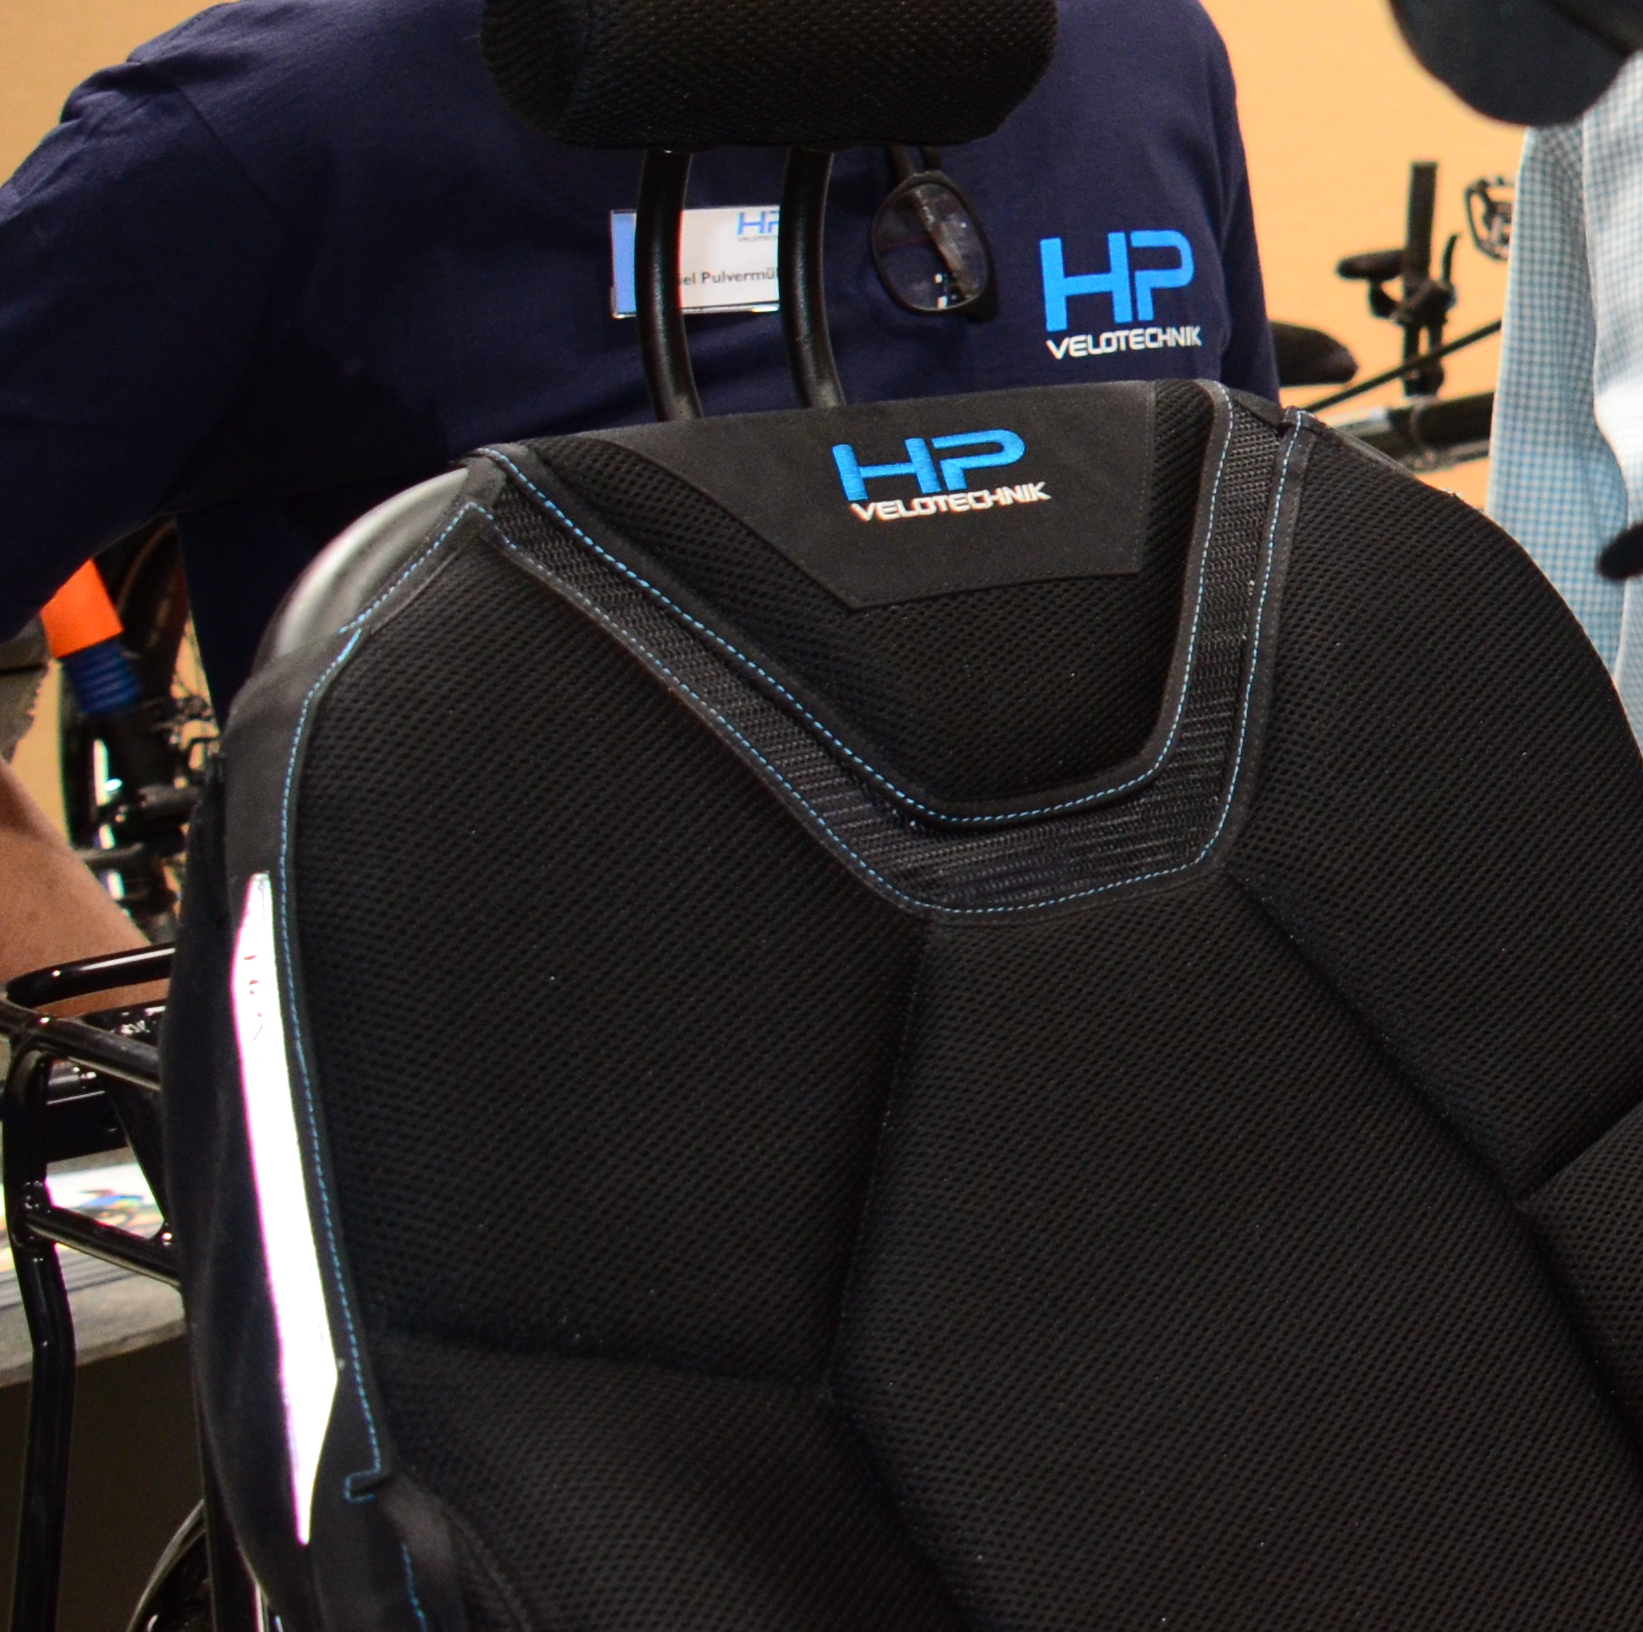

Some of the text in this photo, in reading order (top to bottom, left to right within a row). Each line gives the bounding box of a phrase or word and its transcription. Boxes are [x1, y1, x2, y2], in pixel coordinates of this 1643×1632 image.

[701, 267, 777, 283] Pulvermü
[1040, 230, 1194, 332] HP
[1046, 326, 1202, 360] VELOTECHNIK
[832, 428, 1026, 501] HP
[850, 481, 1051, 522] VELOTECHNIK
